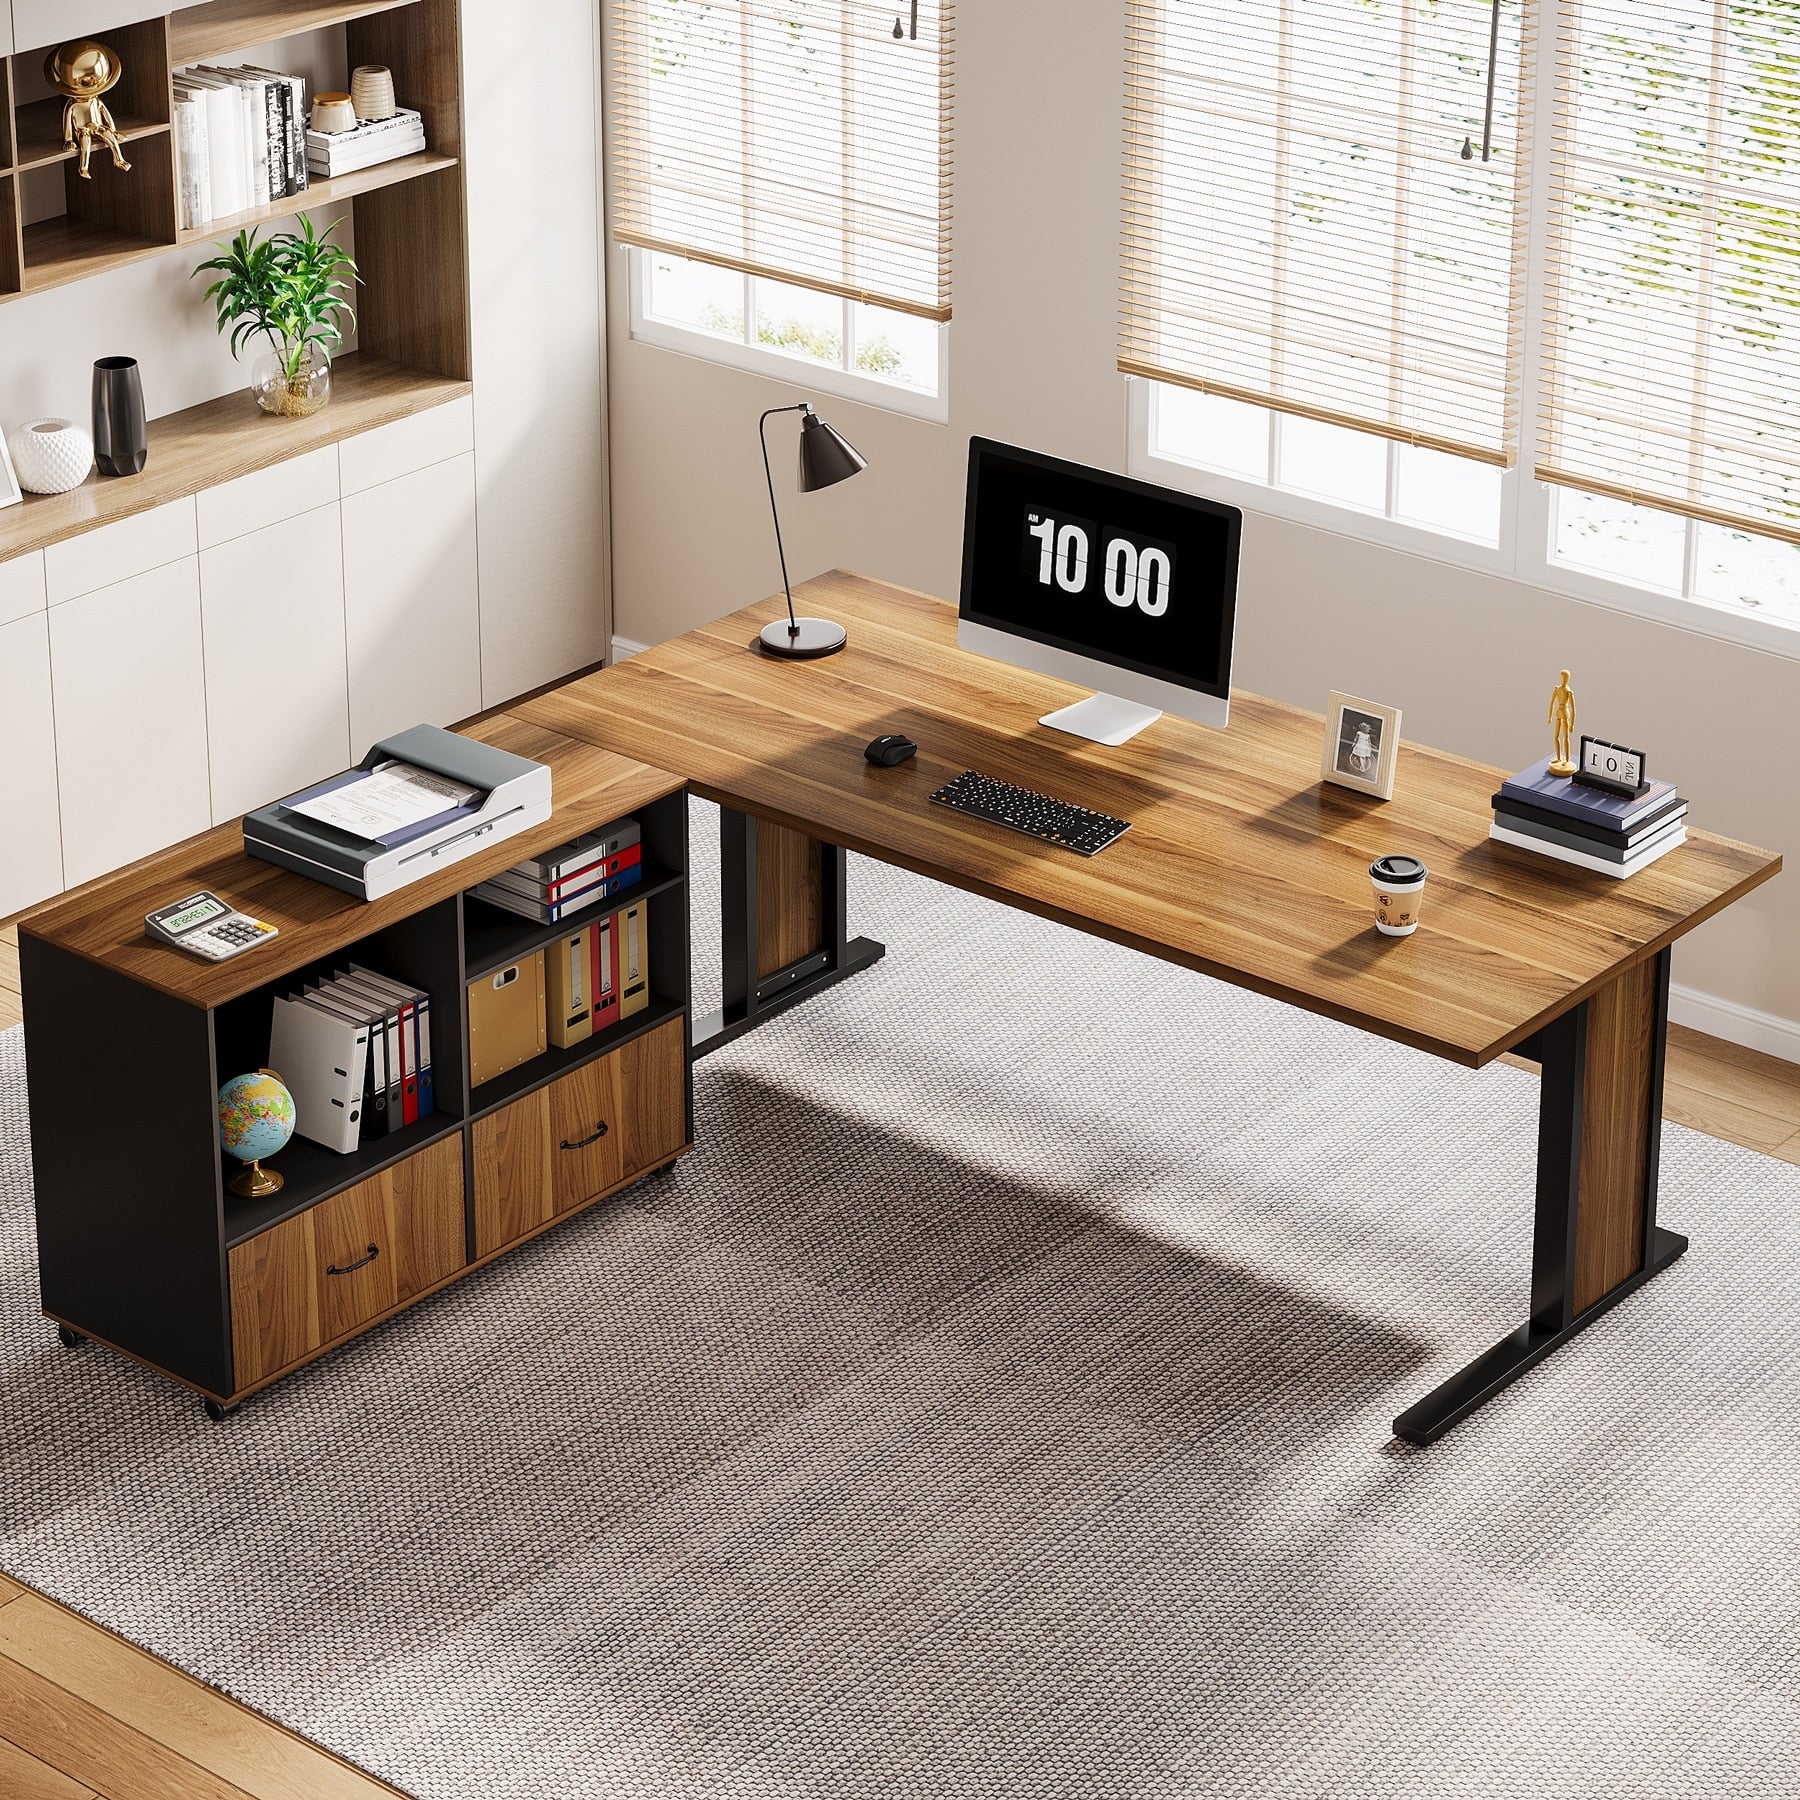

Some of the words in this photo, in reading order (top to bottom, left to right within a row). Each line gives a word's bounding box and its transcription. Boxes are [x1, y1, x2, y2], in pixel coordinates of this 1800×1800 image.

[1028, 513, 1039, 523] AM
[1030, 518, 1088, 593] 10
[1104, 538, 1170, 617] 00
